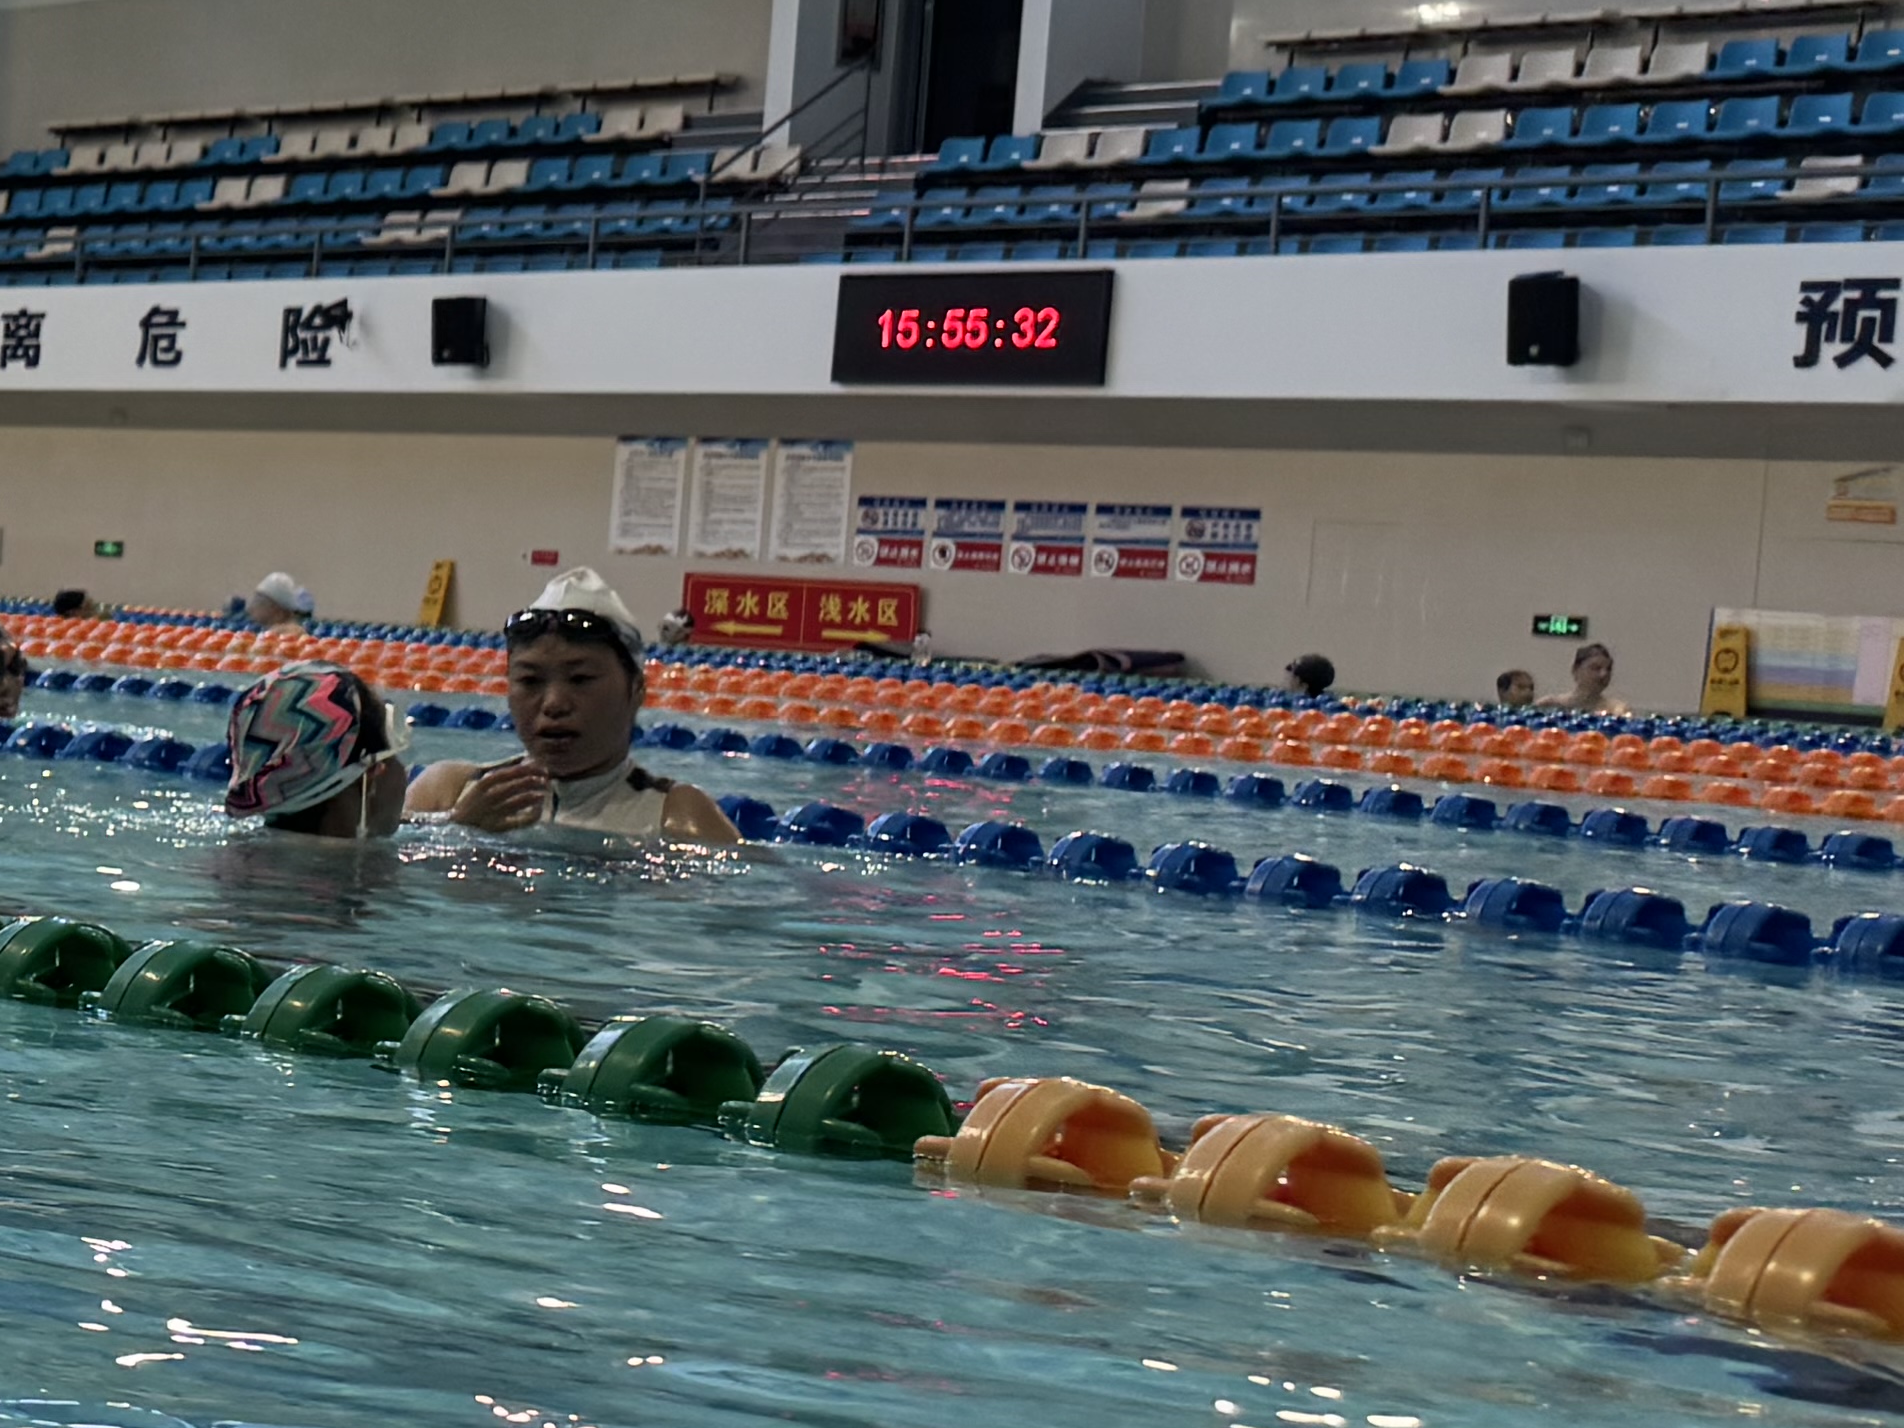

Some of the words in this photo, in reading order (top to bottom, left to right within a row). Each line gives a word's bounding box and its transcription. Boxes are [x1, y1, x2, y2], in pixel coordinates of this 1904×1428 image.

[876, 306, 1061, 351] 15:55:32
[1793, 277, 1902, 369] 预
[704, 587, 790, 620] 深水区
[819, 592, 898, 627] 浅水区
